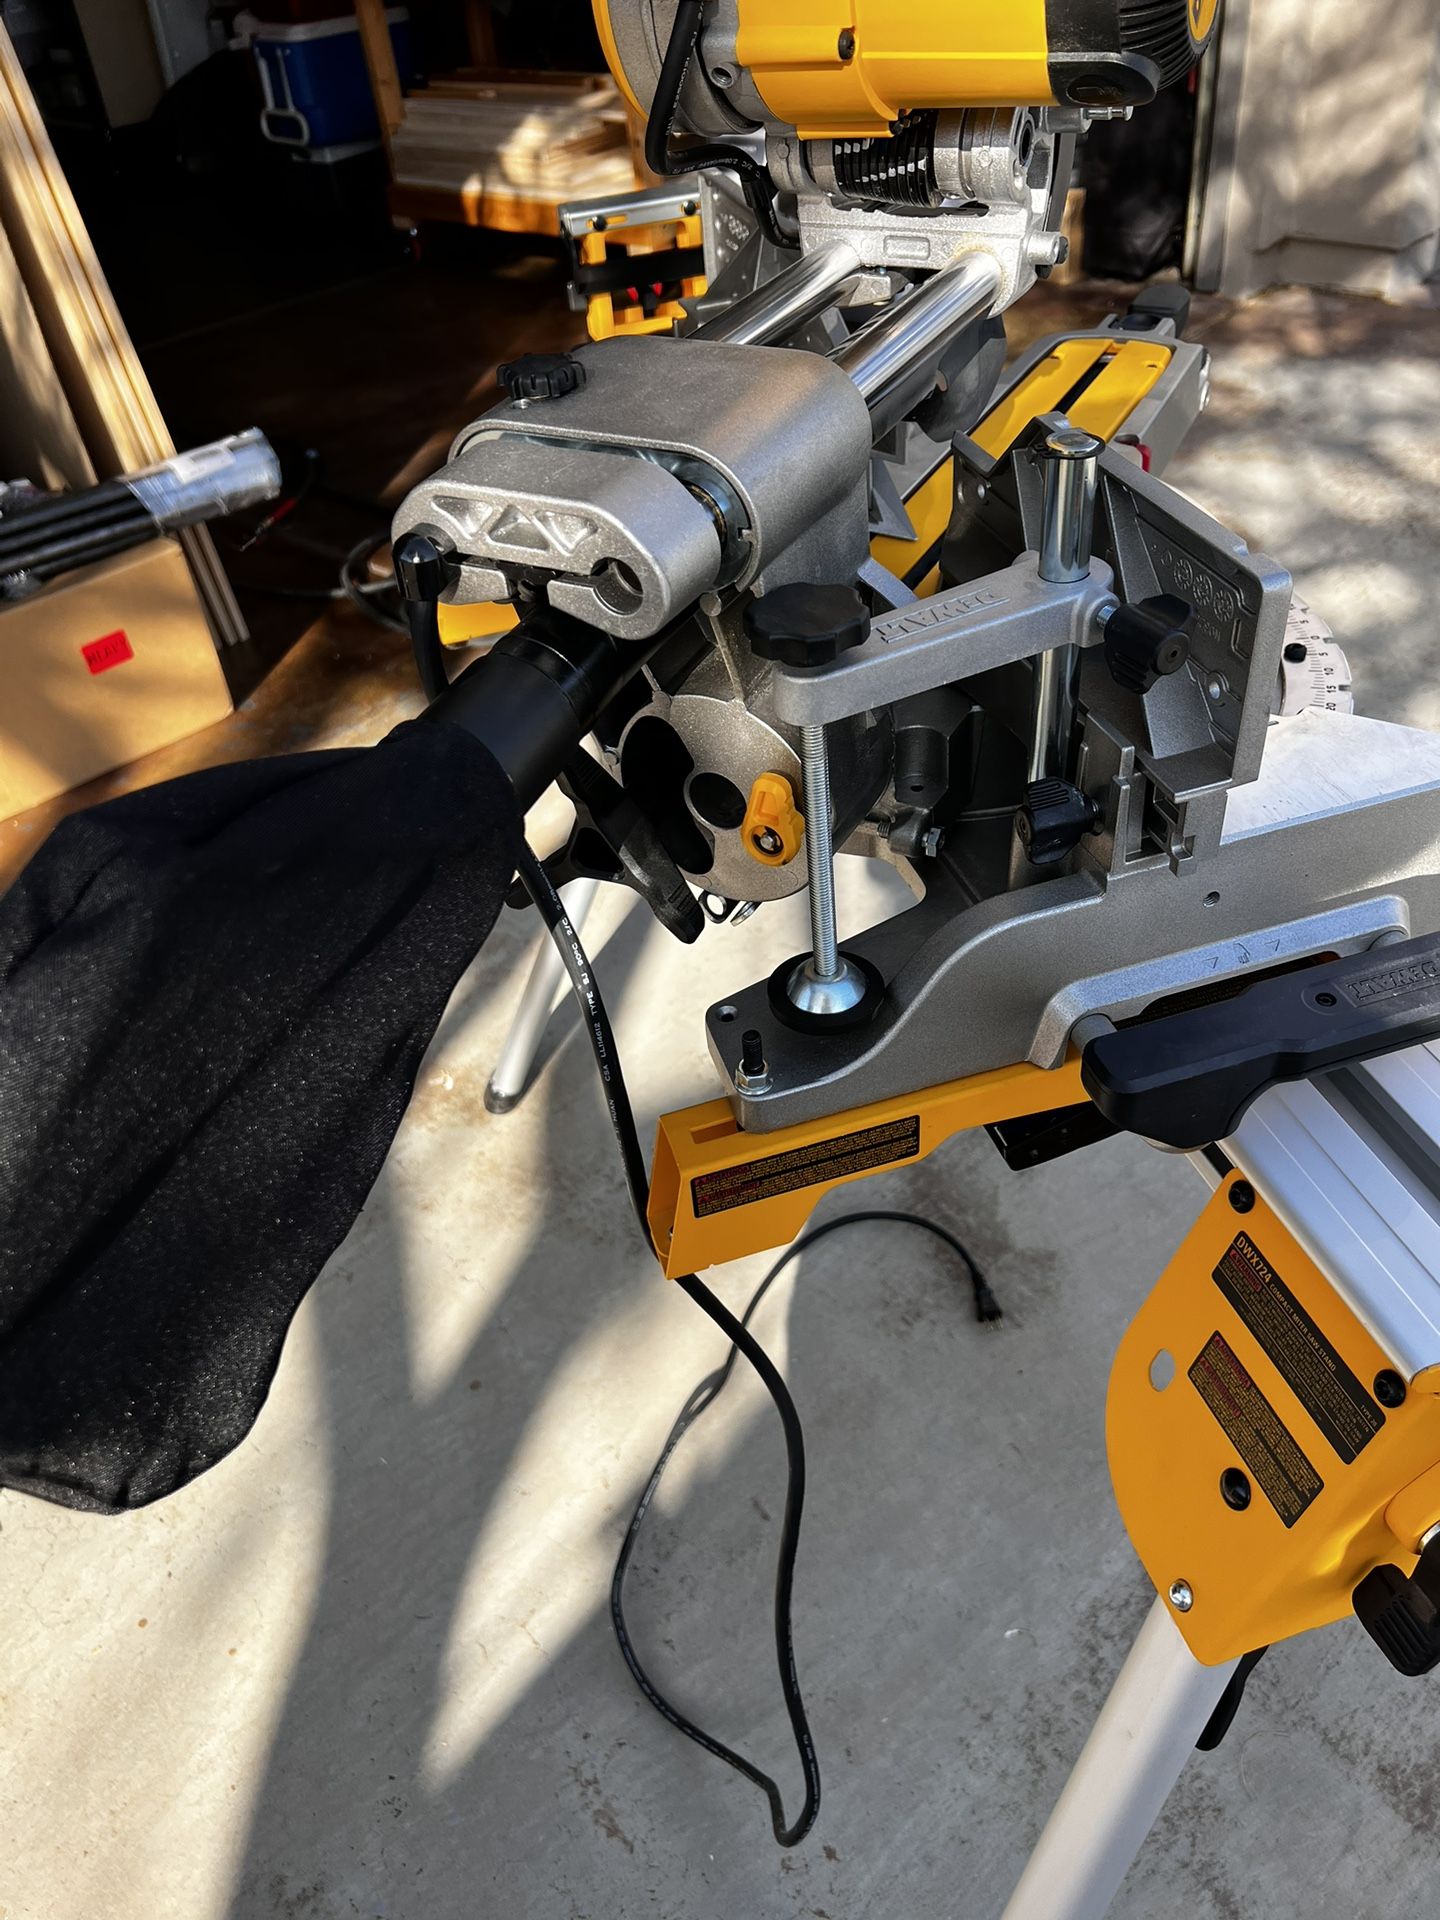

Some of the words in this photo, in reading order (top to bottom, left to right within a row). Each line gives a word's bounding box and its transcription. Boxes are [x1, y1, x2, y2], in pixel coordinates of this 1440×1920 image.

[876, 586, 1010, 644] DEWALT
[1323, 667, 1334, 676] 10
[1326, 685, 1337, 694] 15
[1325, 702, 1336, 711] 20
[562, 917, 573, 936] 2/C
[586, 991, 598, 1016] TYPE
[1237, 1236, 1271, 1283] DWX724
[1269, 1283, 1292, 1314] COMPACT
[1291, 1312, 1308, 1334] MITER
[1306, 1332, 1320, 1350] SAW
[1317, 1347, 1336, 1372] STAND
[1359, 1403, 1373, 1421] TYPE
